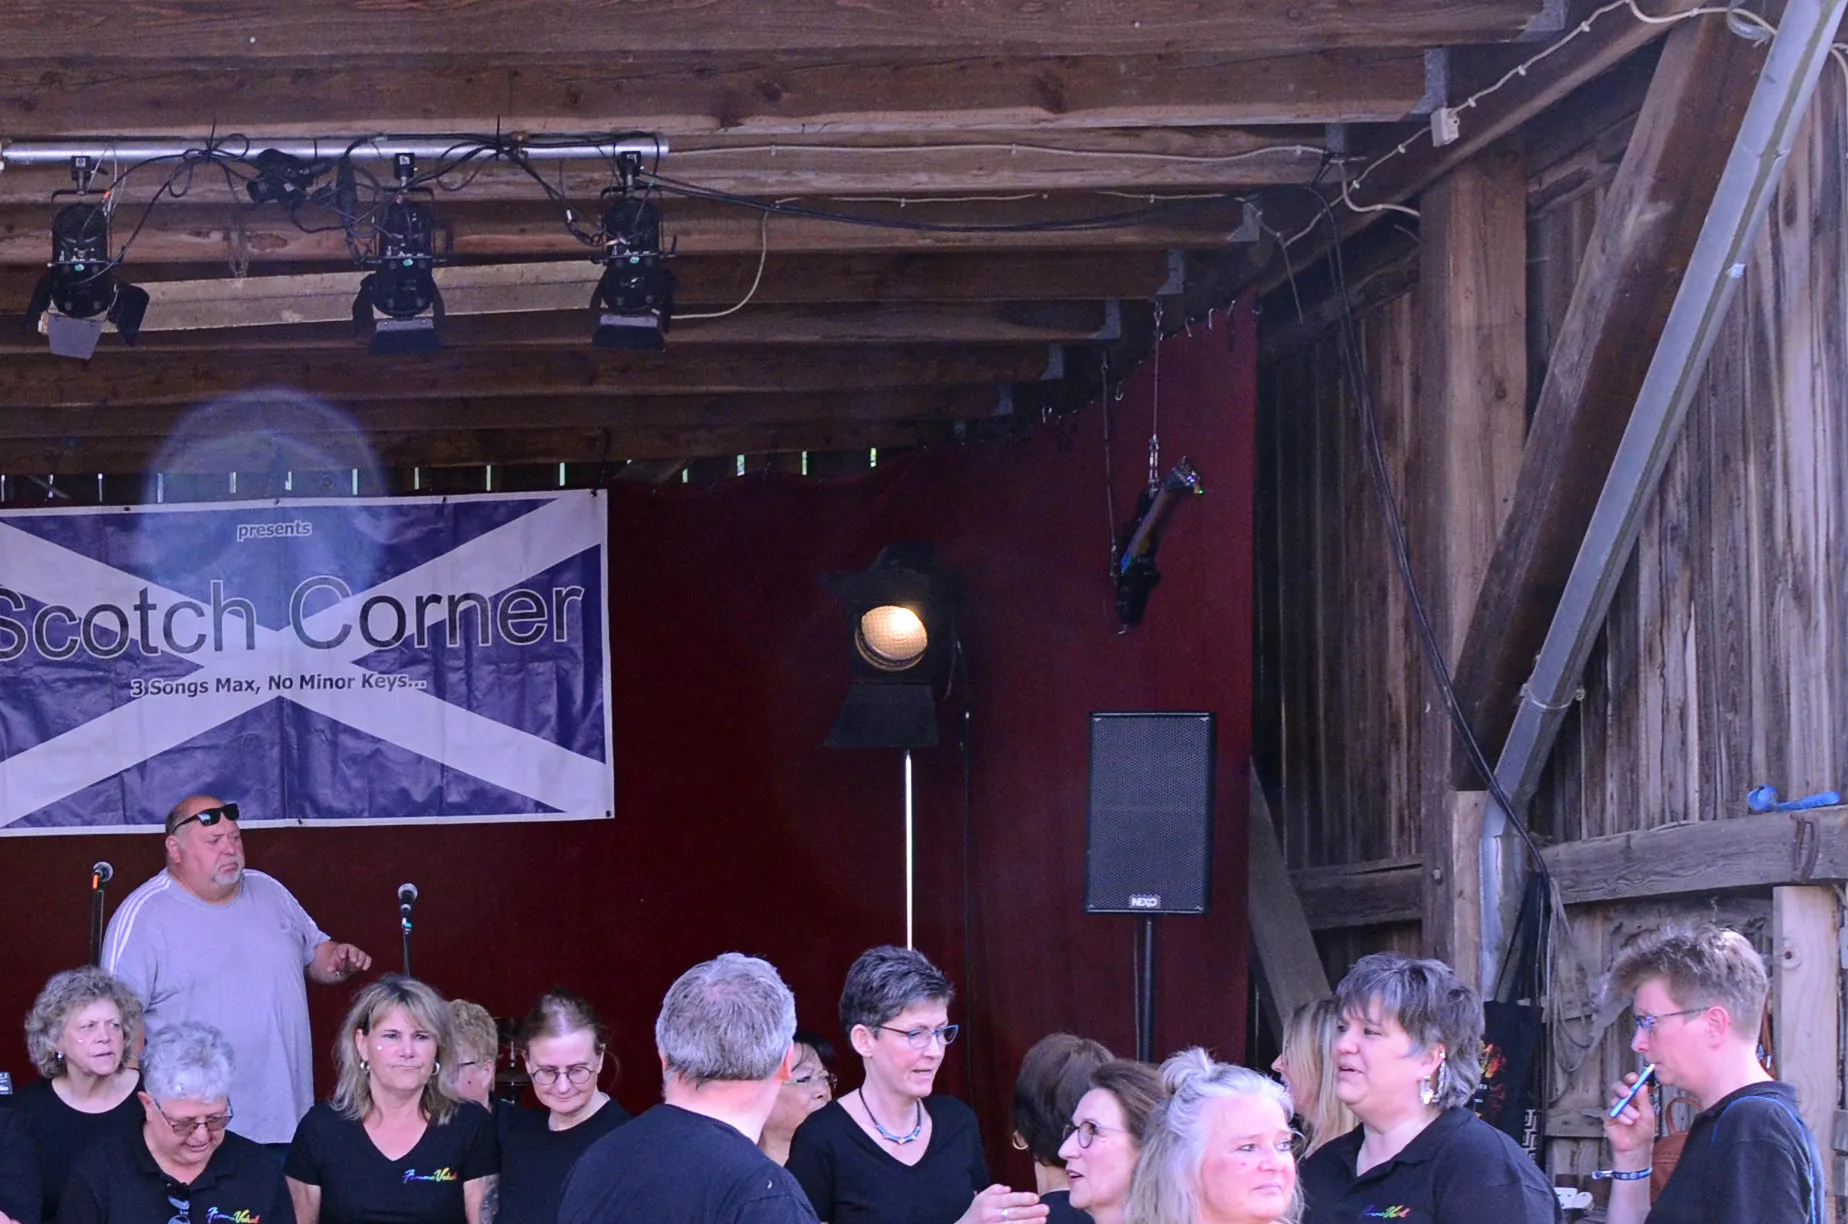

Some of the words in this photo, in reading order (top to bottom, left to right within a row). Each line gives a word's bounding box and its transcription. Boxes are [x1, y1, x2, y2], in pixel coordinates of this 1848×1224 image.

[237, 520, 312, 542] presents
[289, 574, 585, 649] Corner
[132, 680, 145, 696] 3
[149, 679, 209, 698] Songs
[215, 677, 261, 695] Max,
[268, 674, 294, 691] No
[299, 673, 356, 690] Minor
[361, 672, 427, 692] Keys...
